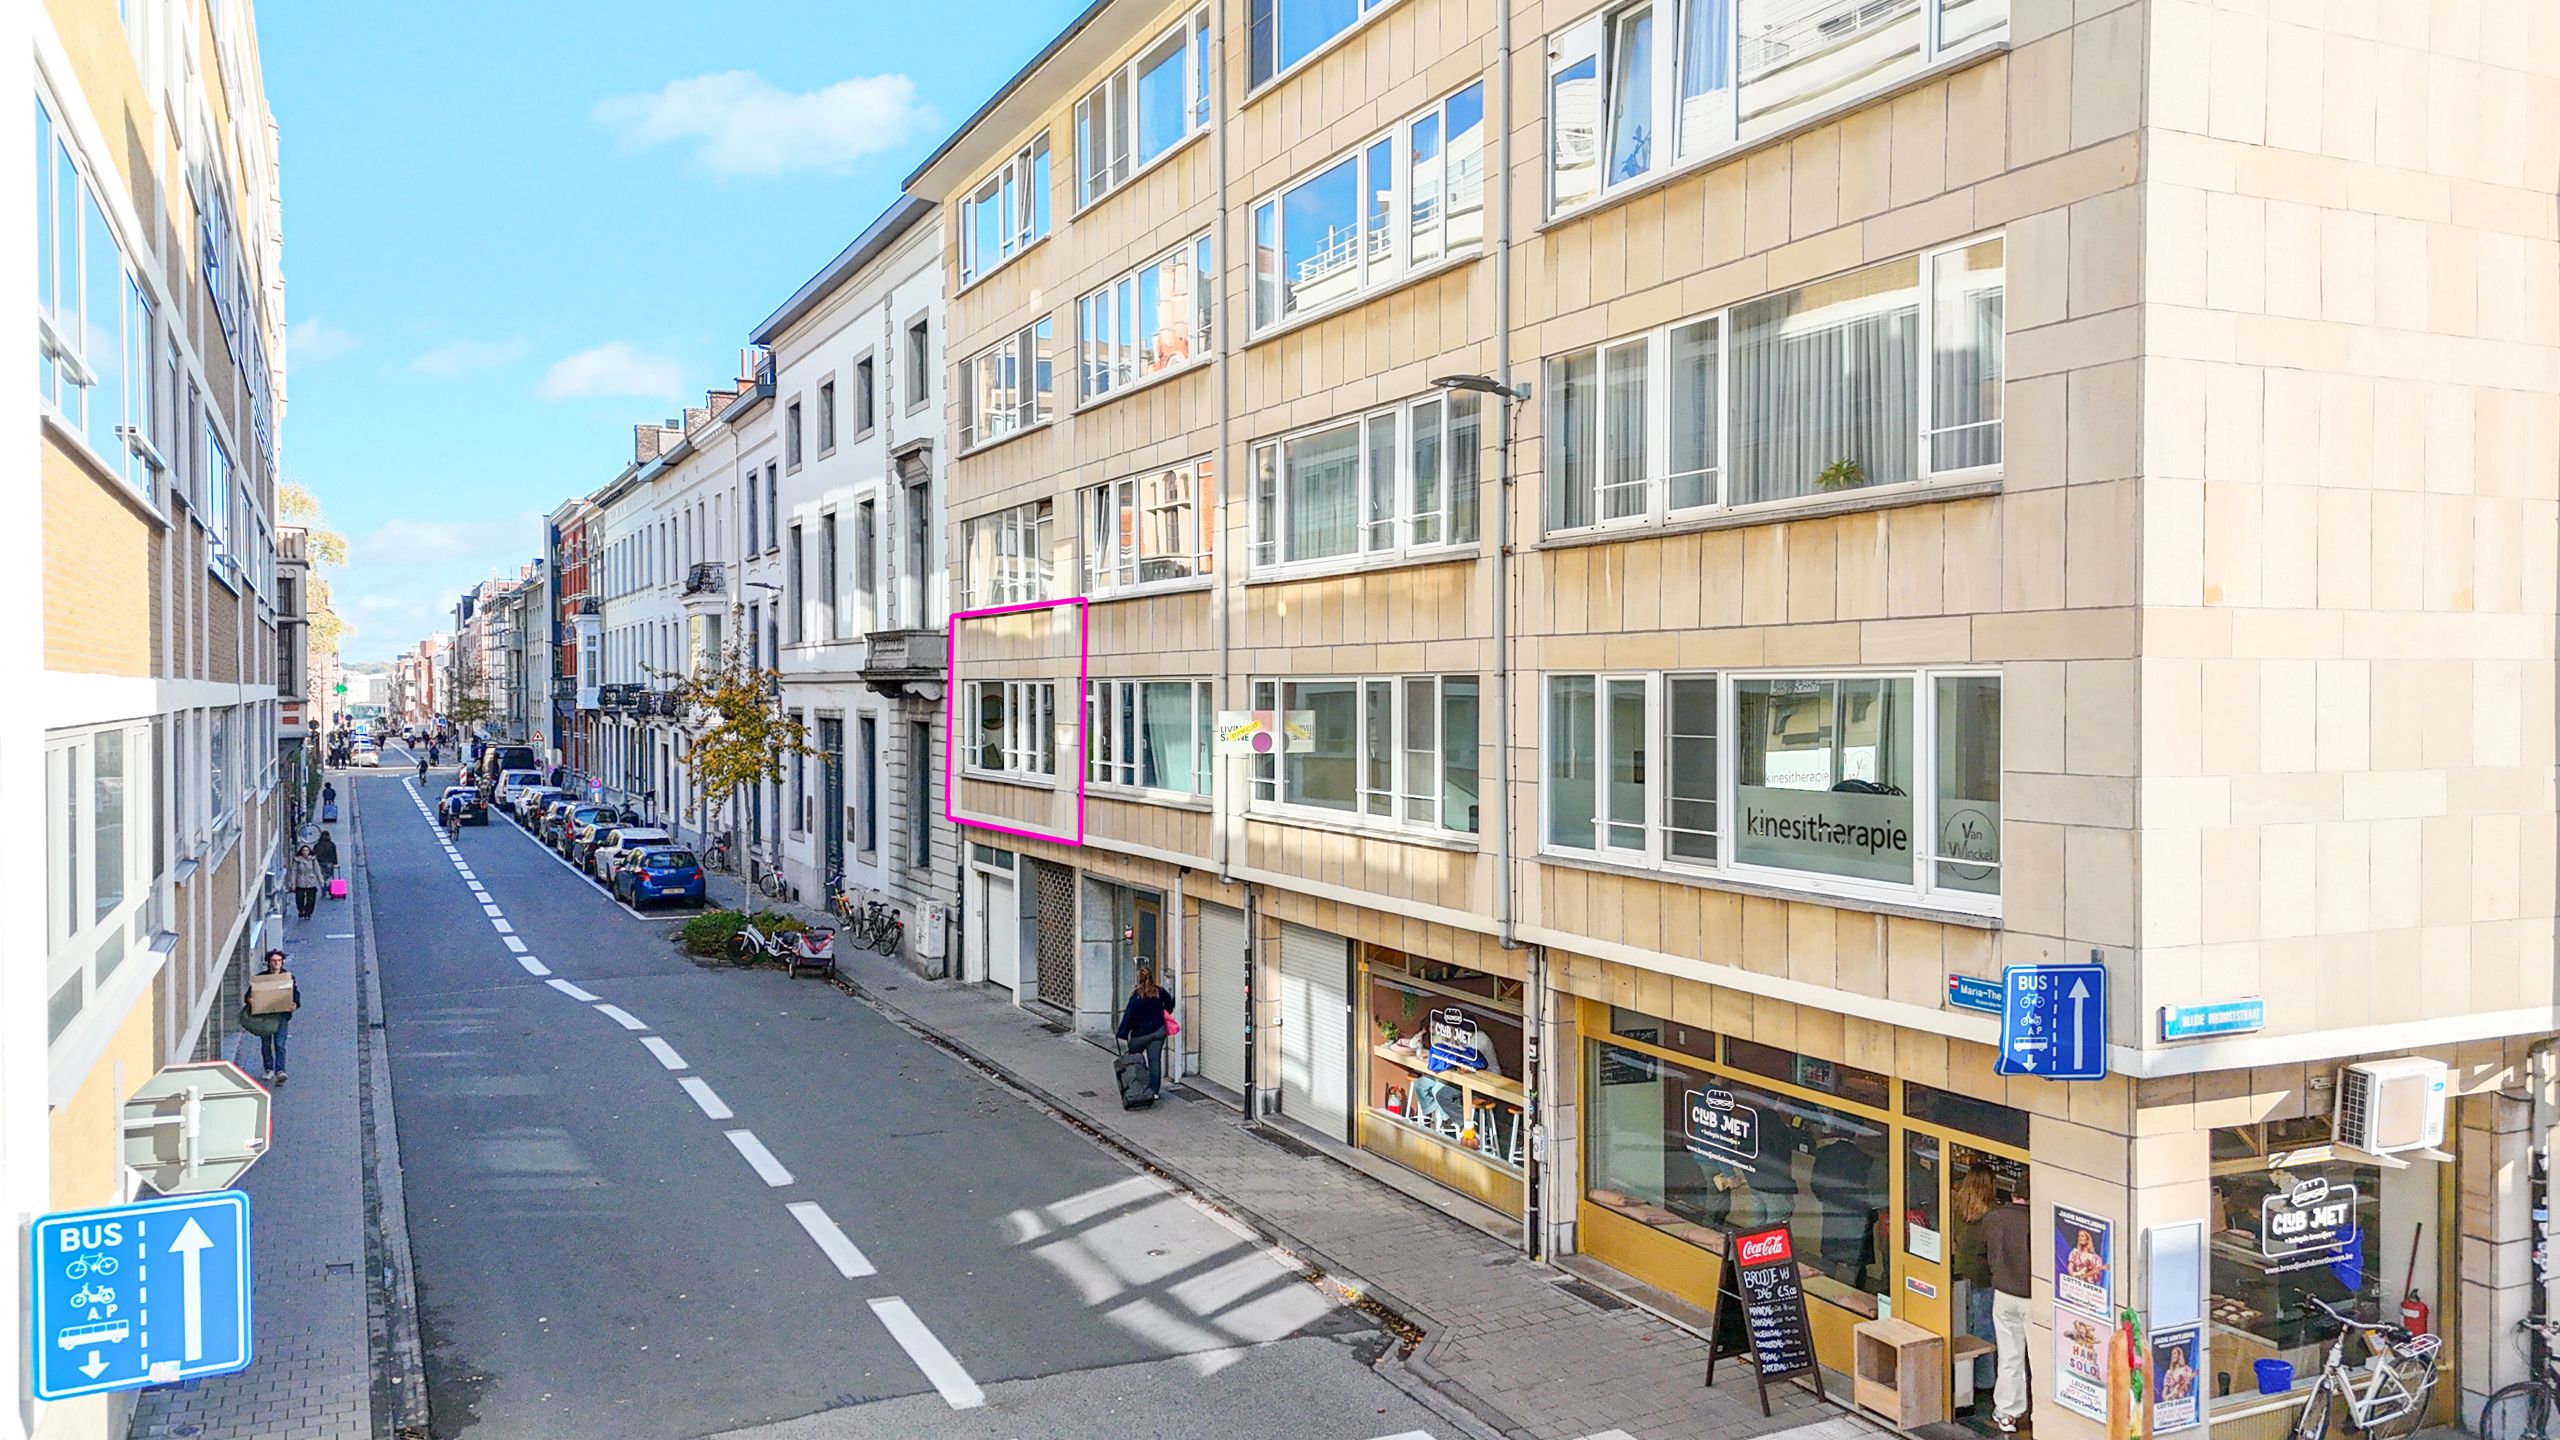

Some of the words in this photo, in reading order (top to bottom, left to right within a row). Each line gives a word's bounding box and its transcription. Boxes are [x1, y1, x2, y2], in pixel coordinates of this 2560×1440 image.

[1747, 807, 1908, 855] kinesitherapie
[1961, 820, 1983, 840] Van
[2018, 975, 2048, 991] BUS
[1435, 1022, 1452, 1039] CLUB
[2027, 1027, 2035, 1036] A
[2036, 1026, 2043, 1035] P
[1691, 1106, 1718, 1128] CLUB
[1720, 1115, 1750, 1138] MET
[2272, 1210, 2307, 1236] CLUB
[2310, 1203, 2349, 1229] MET
[60, 1222, 123, 1252] BUS
[1743, 1267, 1779, 1288] BROODJE
[2062, 1276, 2082, 1287] LOTTO
[2083, 1283, 2103, 1294] ARENA
[1754, 1288, 1772, 1300] DAG
[87, 1307, 101, 1321] A
[106, 1304, 118, 1317] P
[2069, 1358, 2097, 1376] SOLO
[2071, 1379, 2096, 1394] LEUVEN
[2156, 1402, 2174, 1410] LOTTO
